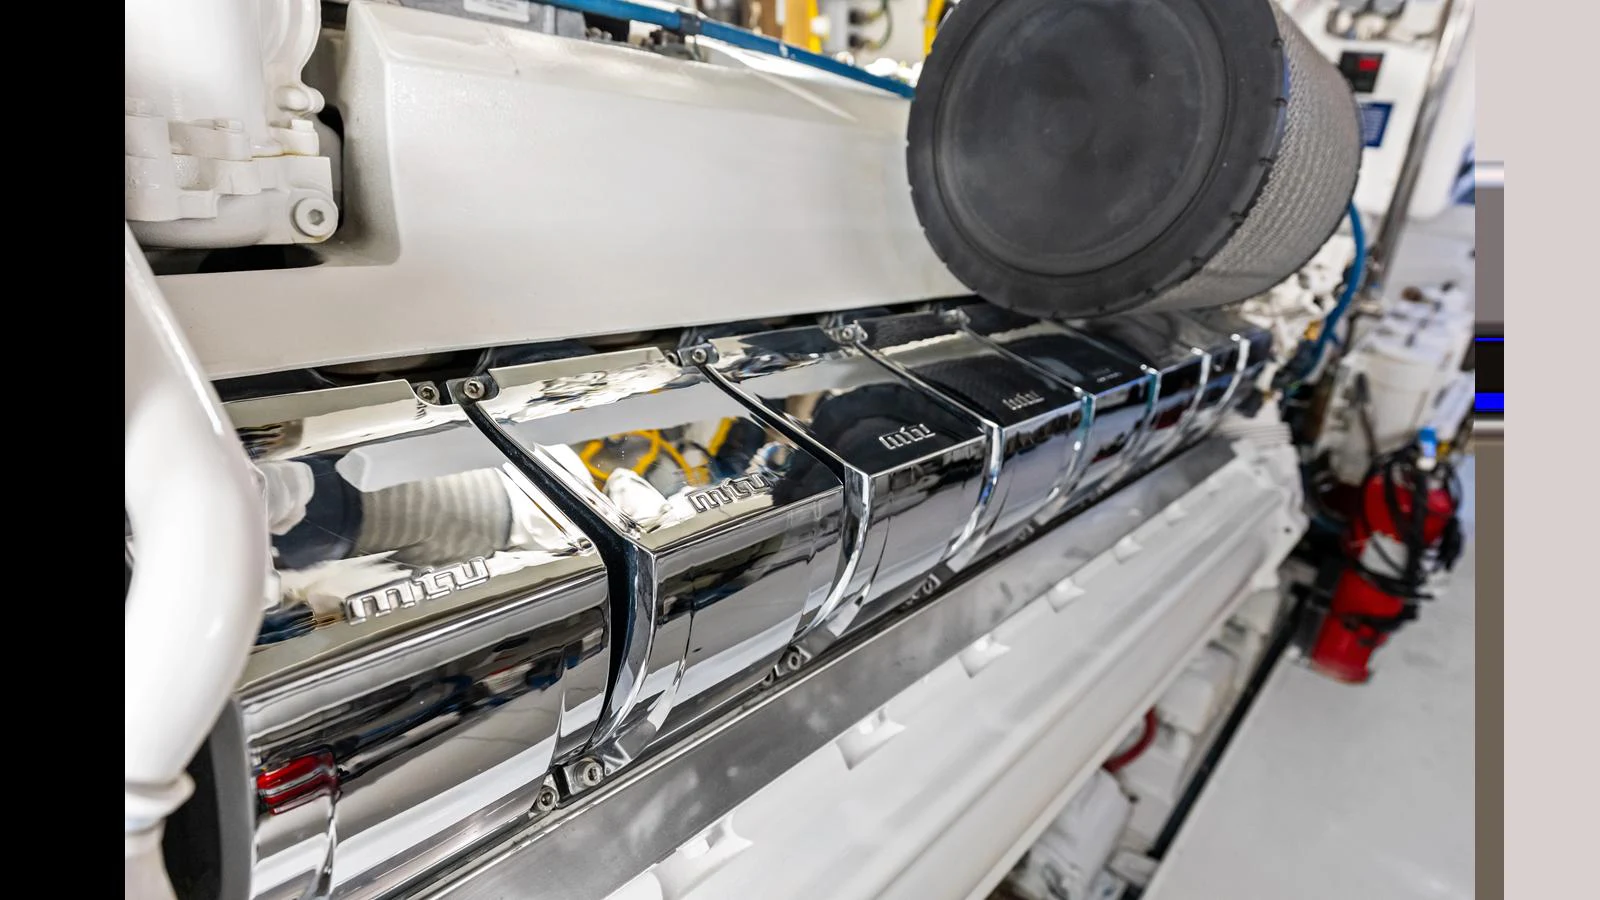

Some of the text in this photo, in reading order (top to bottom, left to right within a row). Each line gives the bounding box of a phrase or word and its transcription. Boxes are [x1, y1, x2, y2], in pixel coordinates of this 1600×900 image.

[879, 423, 936, 450] mtu
[688, 473, 772, 513] mtu
[346, 556, 490, 625] mtu
